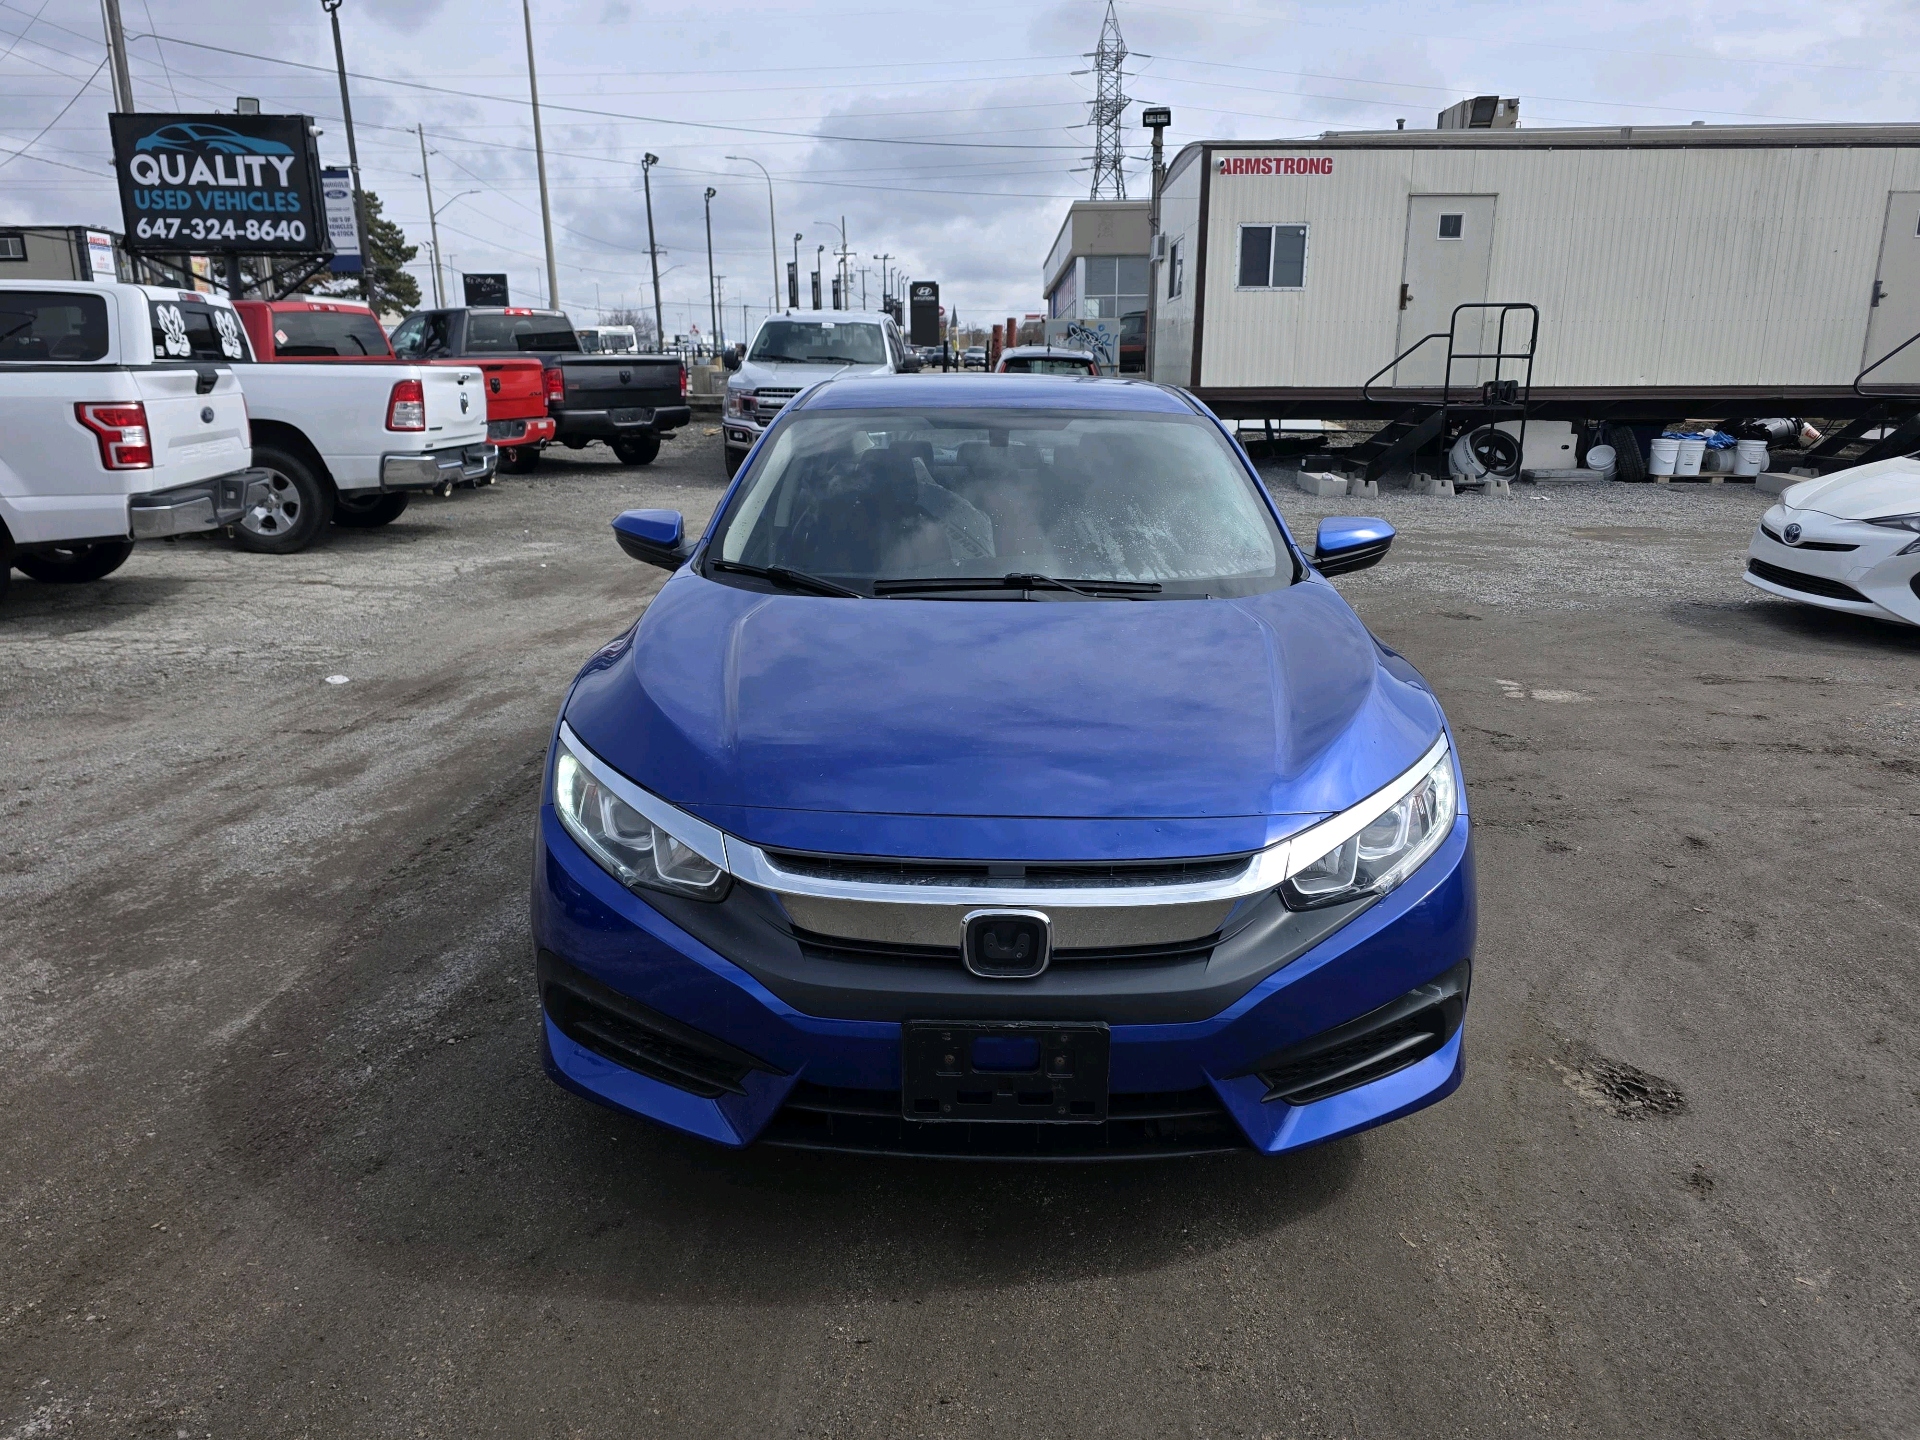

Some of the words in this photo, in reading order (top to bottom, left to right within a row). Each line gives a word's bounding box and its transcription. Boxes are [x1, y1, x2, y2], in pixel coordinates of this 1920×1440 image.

[130, 154, 295, 187] QUALITY
[1220, 157, 1333, 175] ARMSTRONG
[134, 189, 192, 210] USED
[195, 190, 301, 212] VEHICLES
[136, 217, 306, 241] 647-324-8640
